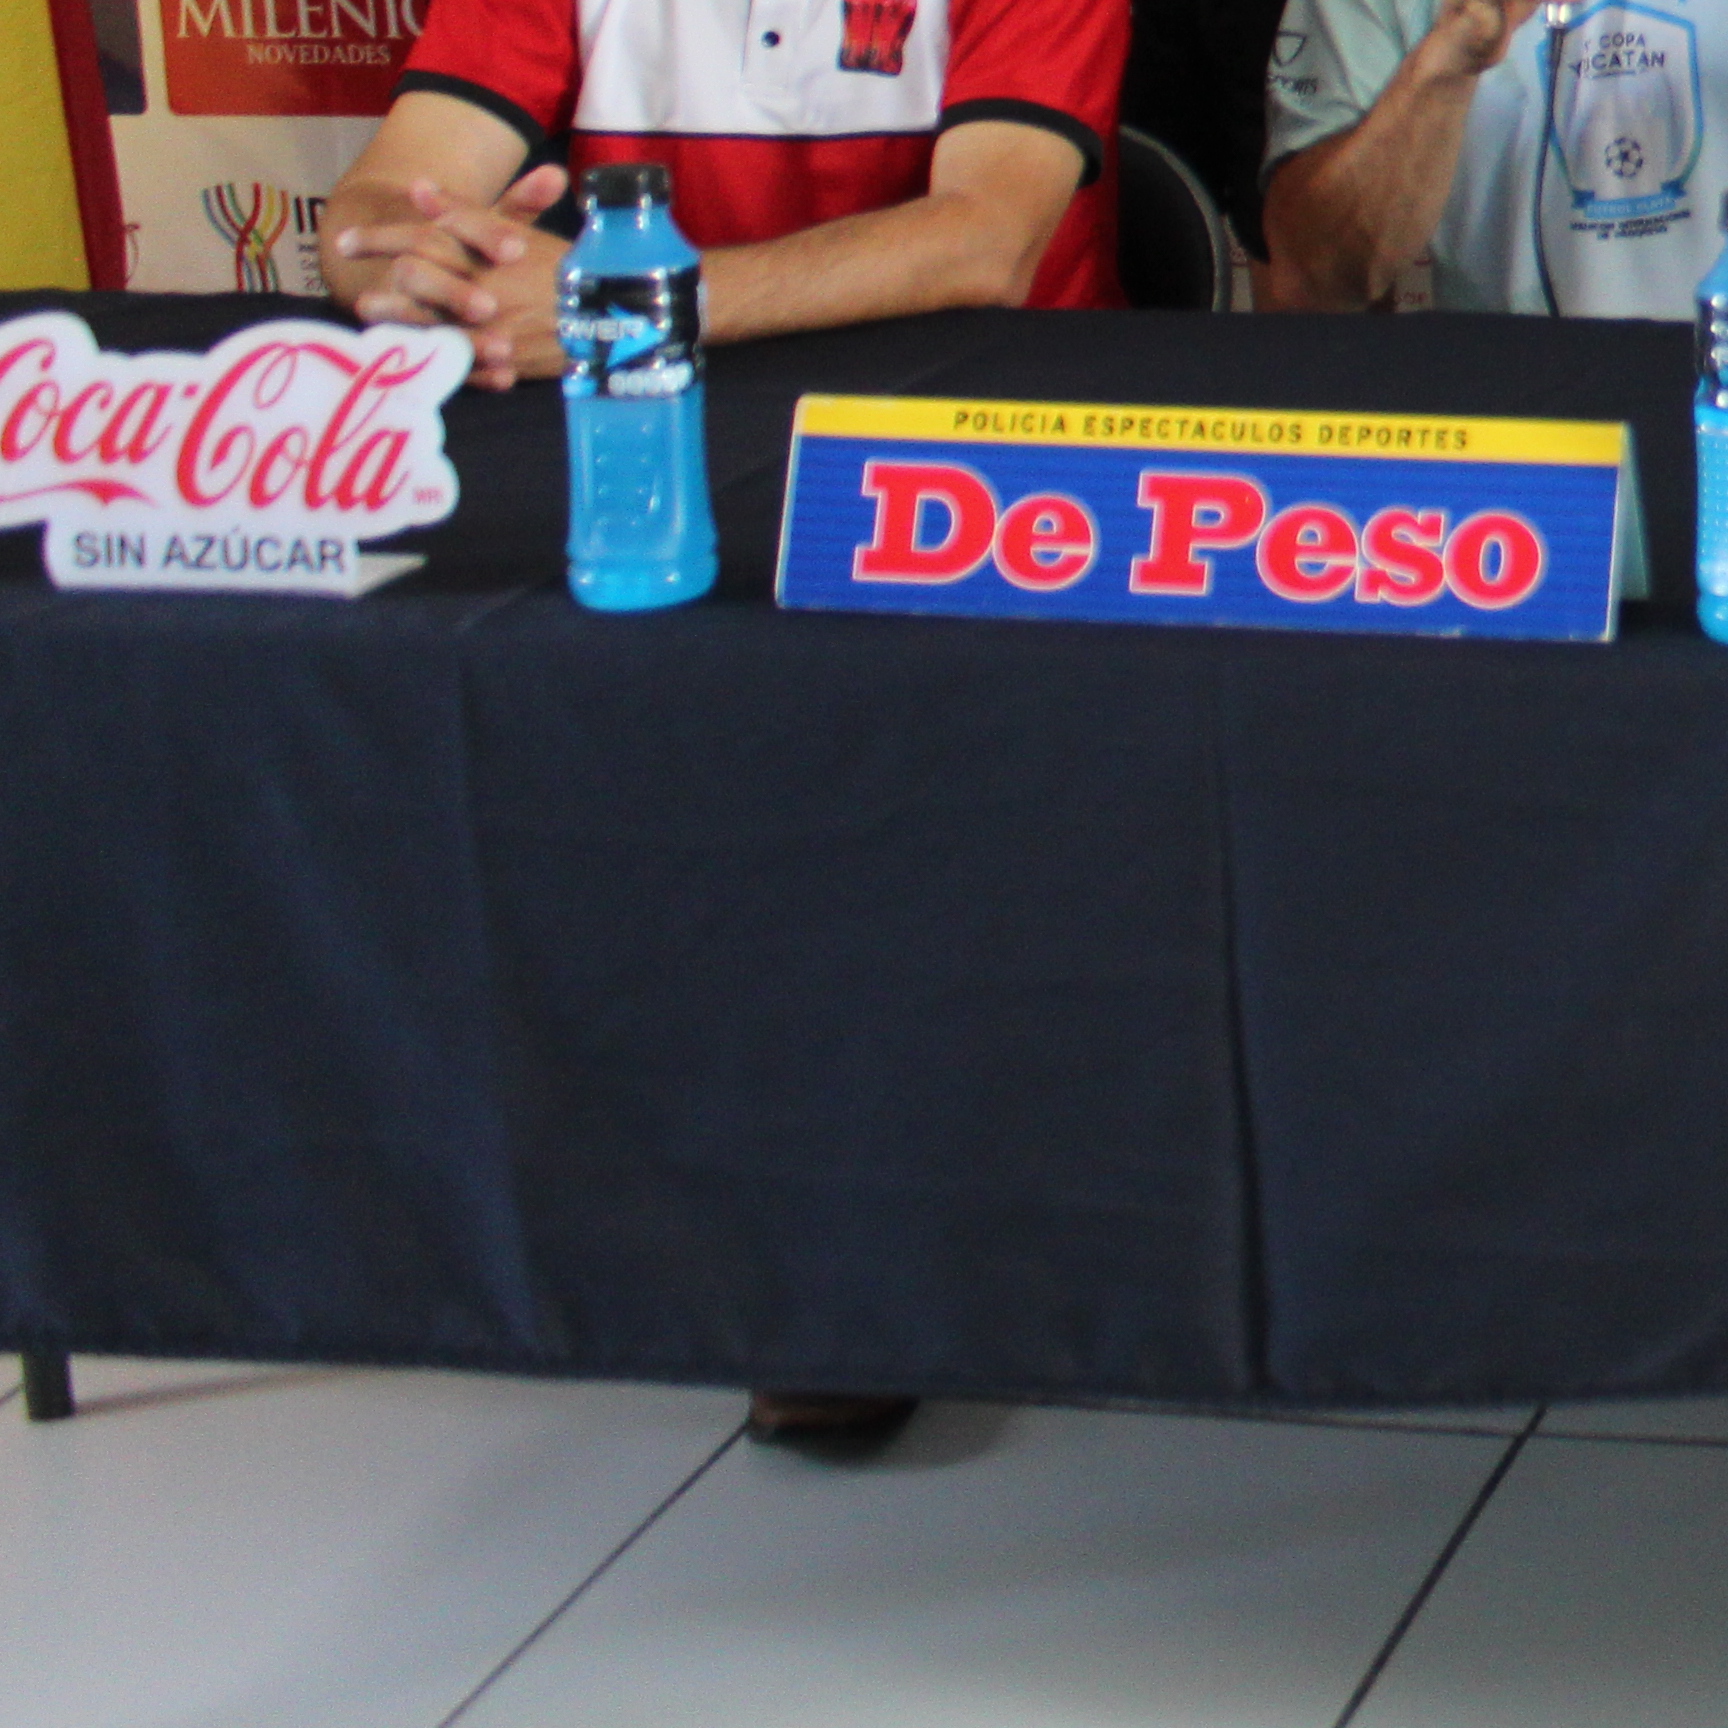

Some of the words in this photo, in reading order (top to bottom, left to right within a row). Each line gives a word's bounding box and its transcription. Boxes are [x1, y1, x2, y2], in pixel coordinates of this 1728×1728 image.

[246, 43, 392, 67] NOVEDADES
[1599, 30, 1647, 50] COPA
[953, 408, 1069, 437] POLICIA
[1082, 412, 1304, 446] ESPECTACULOS
[1317, 423, 1469, 452] DEPORTES
[73, 533, 150, 570] SIN
[161, 526, 346, 574] AZÚCAR
[851, 457, 1098, 592] De
[1129, 468, 1545, 611] Peso
